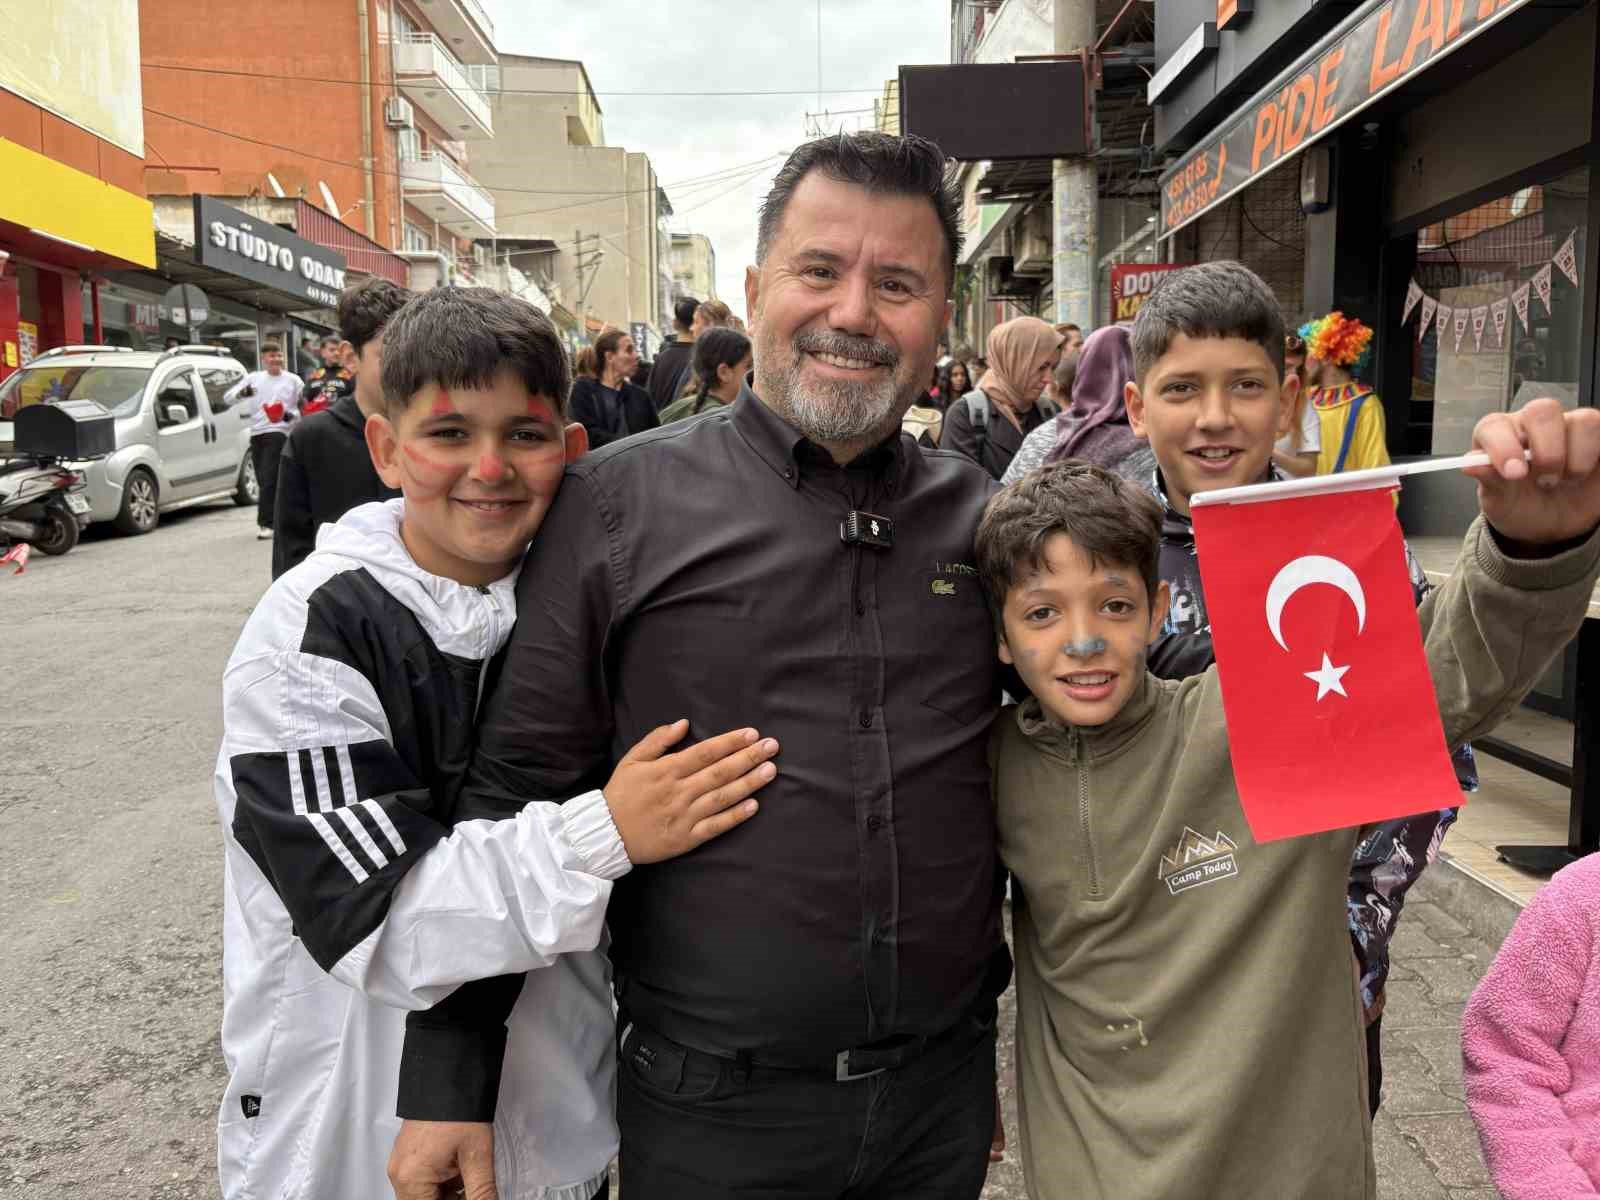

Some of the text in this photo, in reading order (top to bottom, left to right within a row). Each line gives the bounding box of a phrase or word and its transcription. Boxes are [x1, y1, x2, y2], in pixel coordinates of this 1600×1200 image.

[210, 221, 345, 290] STÜDYO ODAK
[1123, 270, 1168, 297] DOY
[1170, 858, 1232, 886] Camp Today
